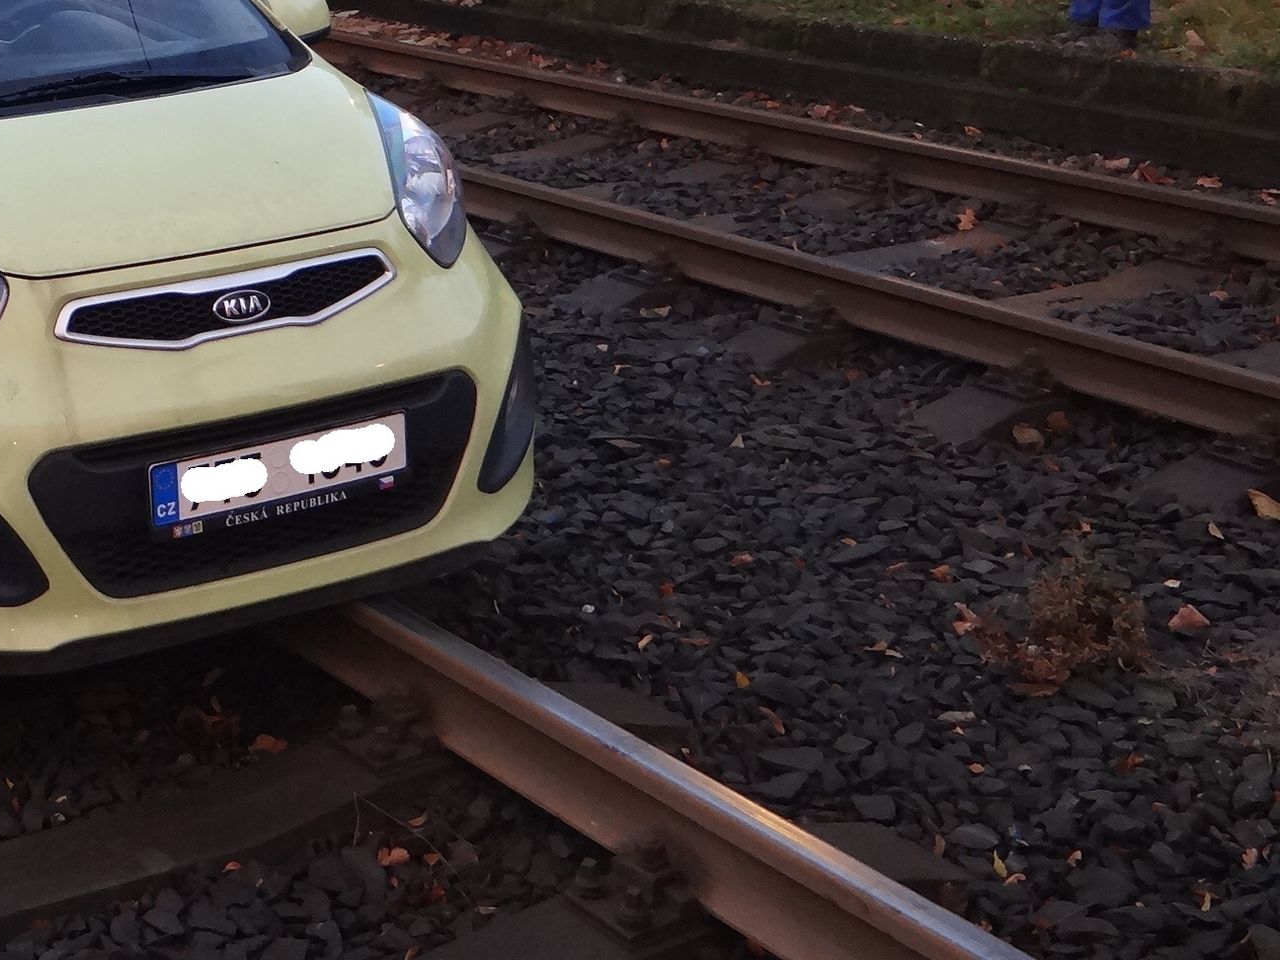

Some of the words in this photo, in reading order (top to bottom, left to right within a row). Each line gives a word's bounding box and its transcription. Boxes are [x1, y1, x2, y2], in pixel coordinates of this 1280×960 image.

[223, 295, 263, 317] KIA
[157, 501, 176, 518] CZ
[225, 506, 268, 527] ČESKÁ
[276, 490, 347, 516] REPUBLIKA
